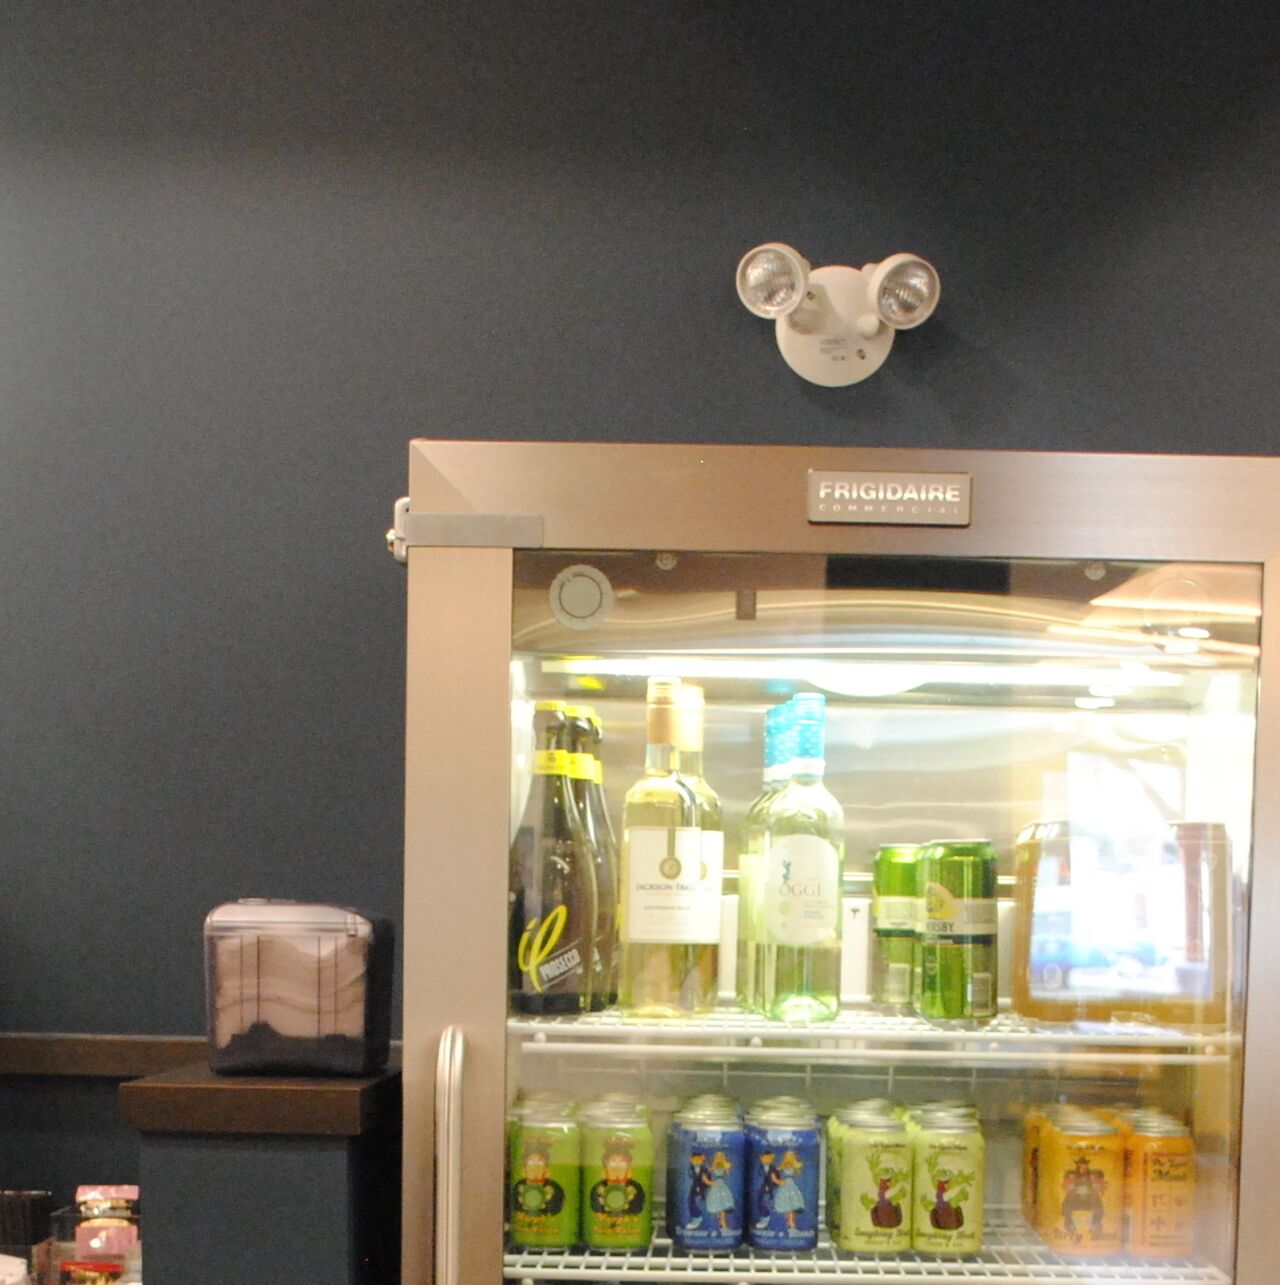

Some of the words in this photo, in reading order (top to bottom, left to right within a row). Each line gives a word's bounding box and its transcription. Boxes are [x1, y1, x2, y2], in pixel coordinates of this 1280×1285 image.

[819, 481, 961, 502] FRIGIDAIRE
[819, 503, 959, 514] COMMERCIAL
[538, 948, 582, 982] PROSECCO
